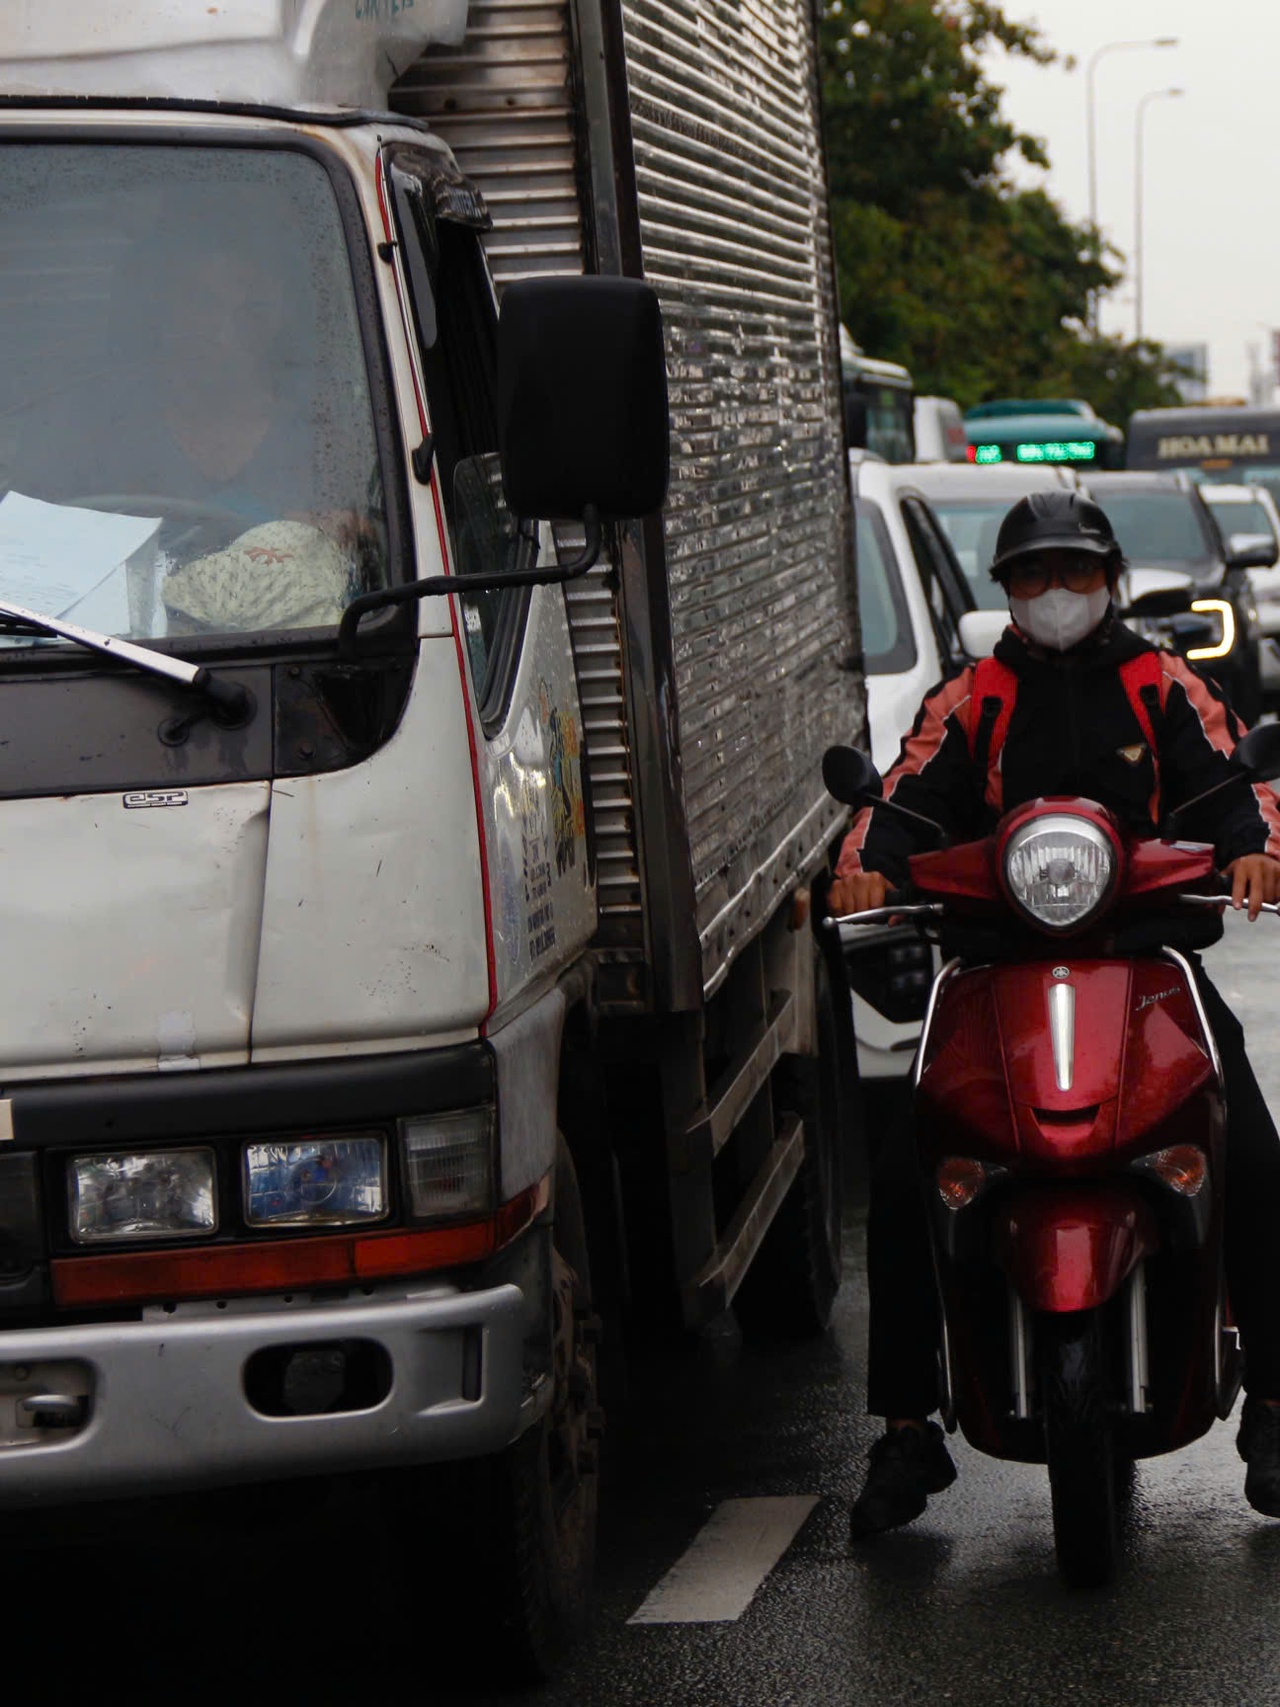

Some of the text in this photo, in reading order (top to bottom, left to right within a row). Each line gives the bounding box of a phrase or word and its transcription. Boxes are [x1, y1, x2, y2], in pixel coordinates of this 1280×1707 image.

[1157, 433, 1269, 458] HOA MAI
[1134, 987, 1181, 1012] Janus
